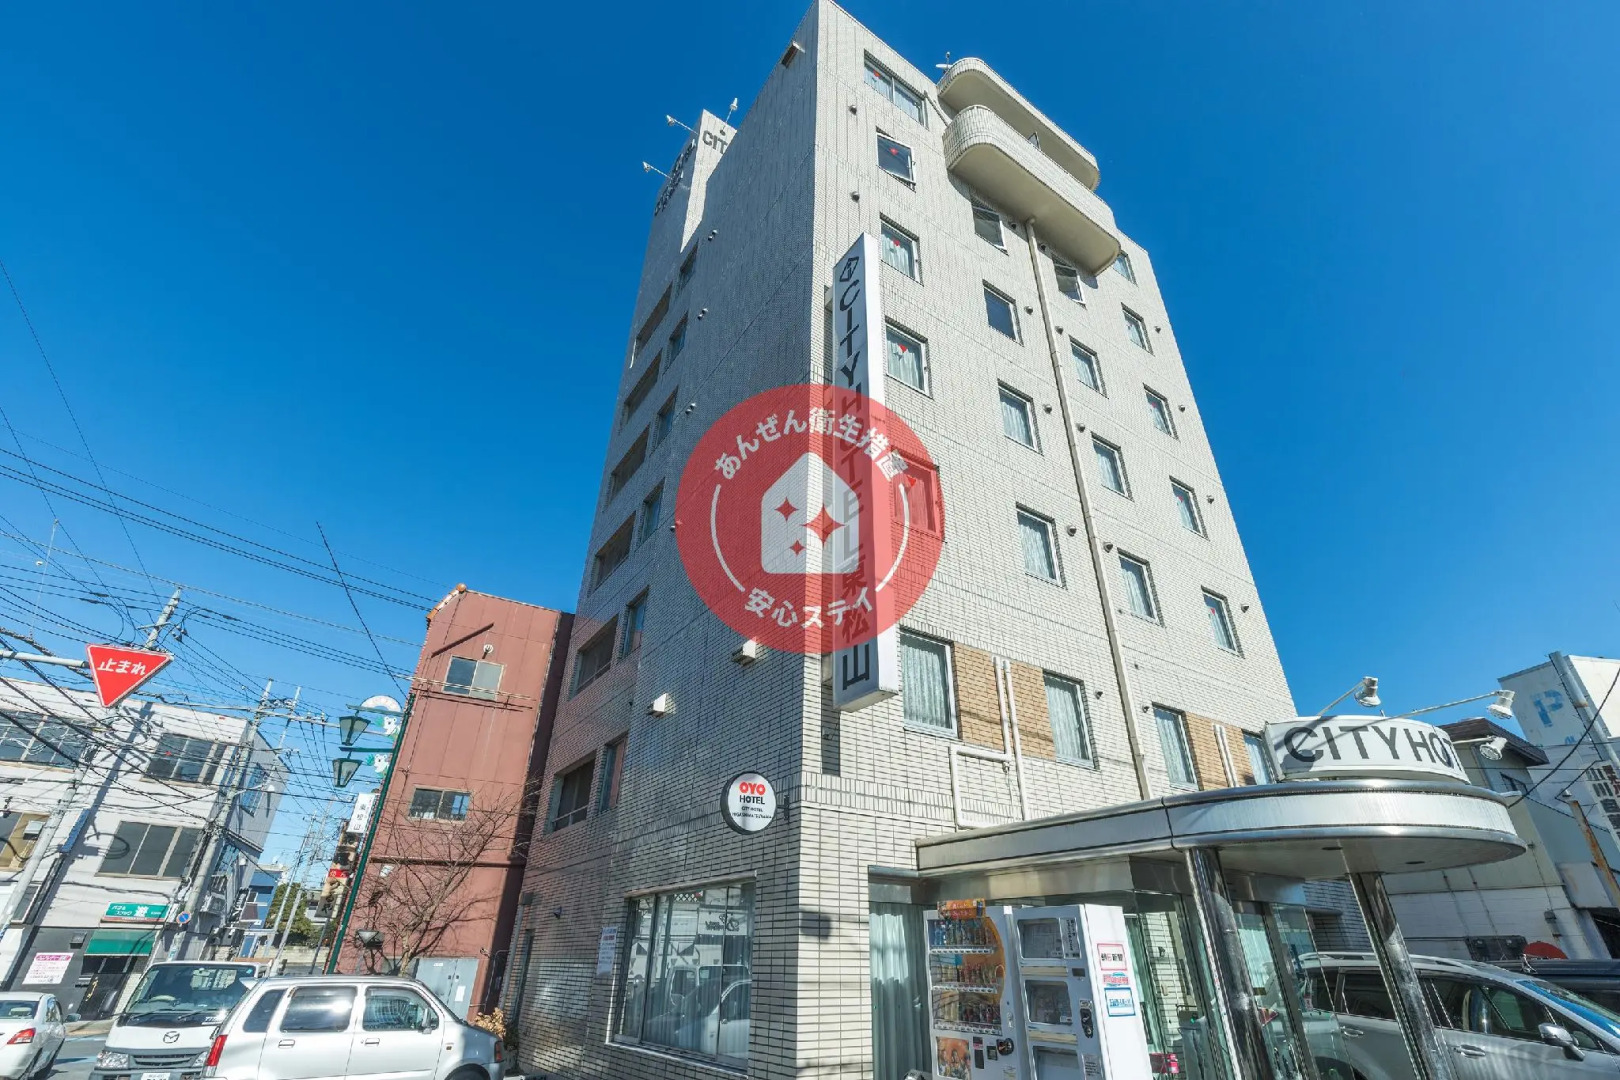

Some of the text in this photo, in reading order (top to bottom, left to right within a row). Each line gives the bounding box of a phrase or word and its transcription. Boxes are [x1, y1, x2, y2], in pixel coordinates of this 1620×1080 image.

[97, 658, 147, 675] 止まれ
[739, 782, 765, 795] OYO
[739, 795, 765, 804] HOTEL
